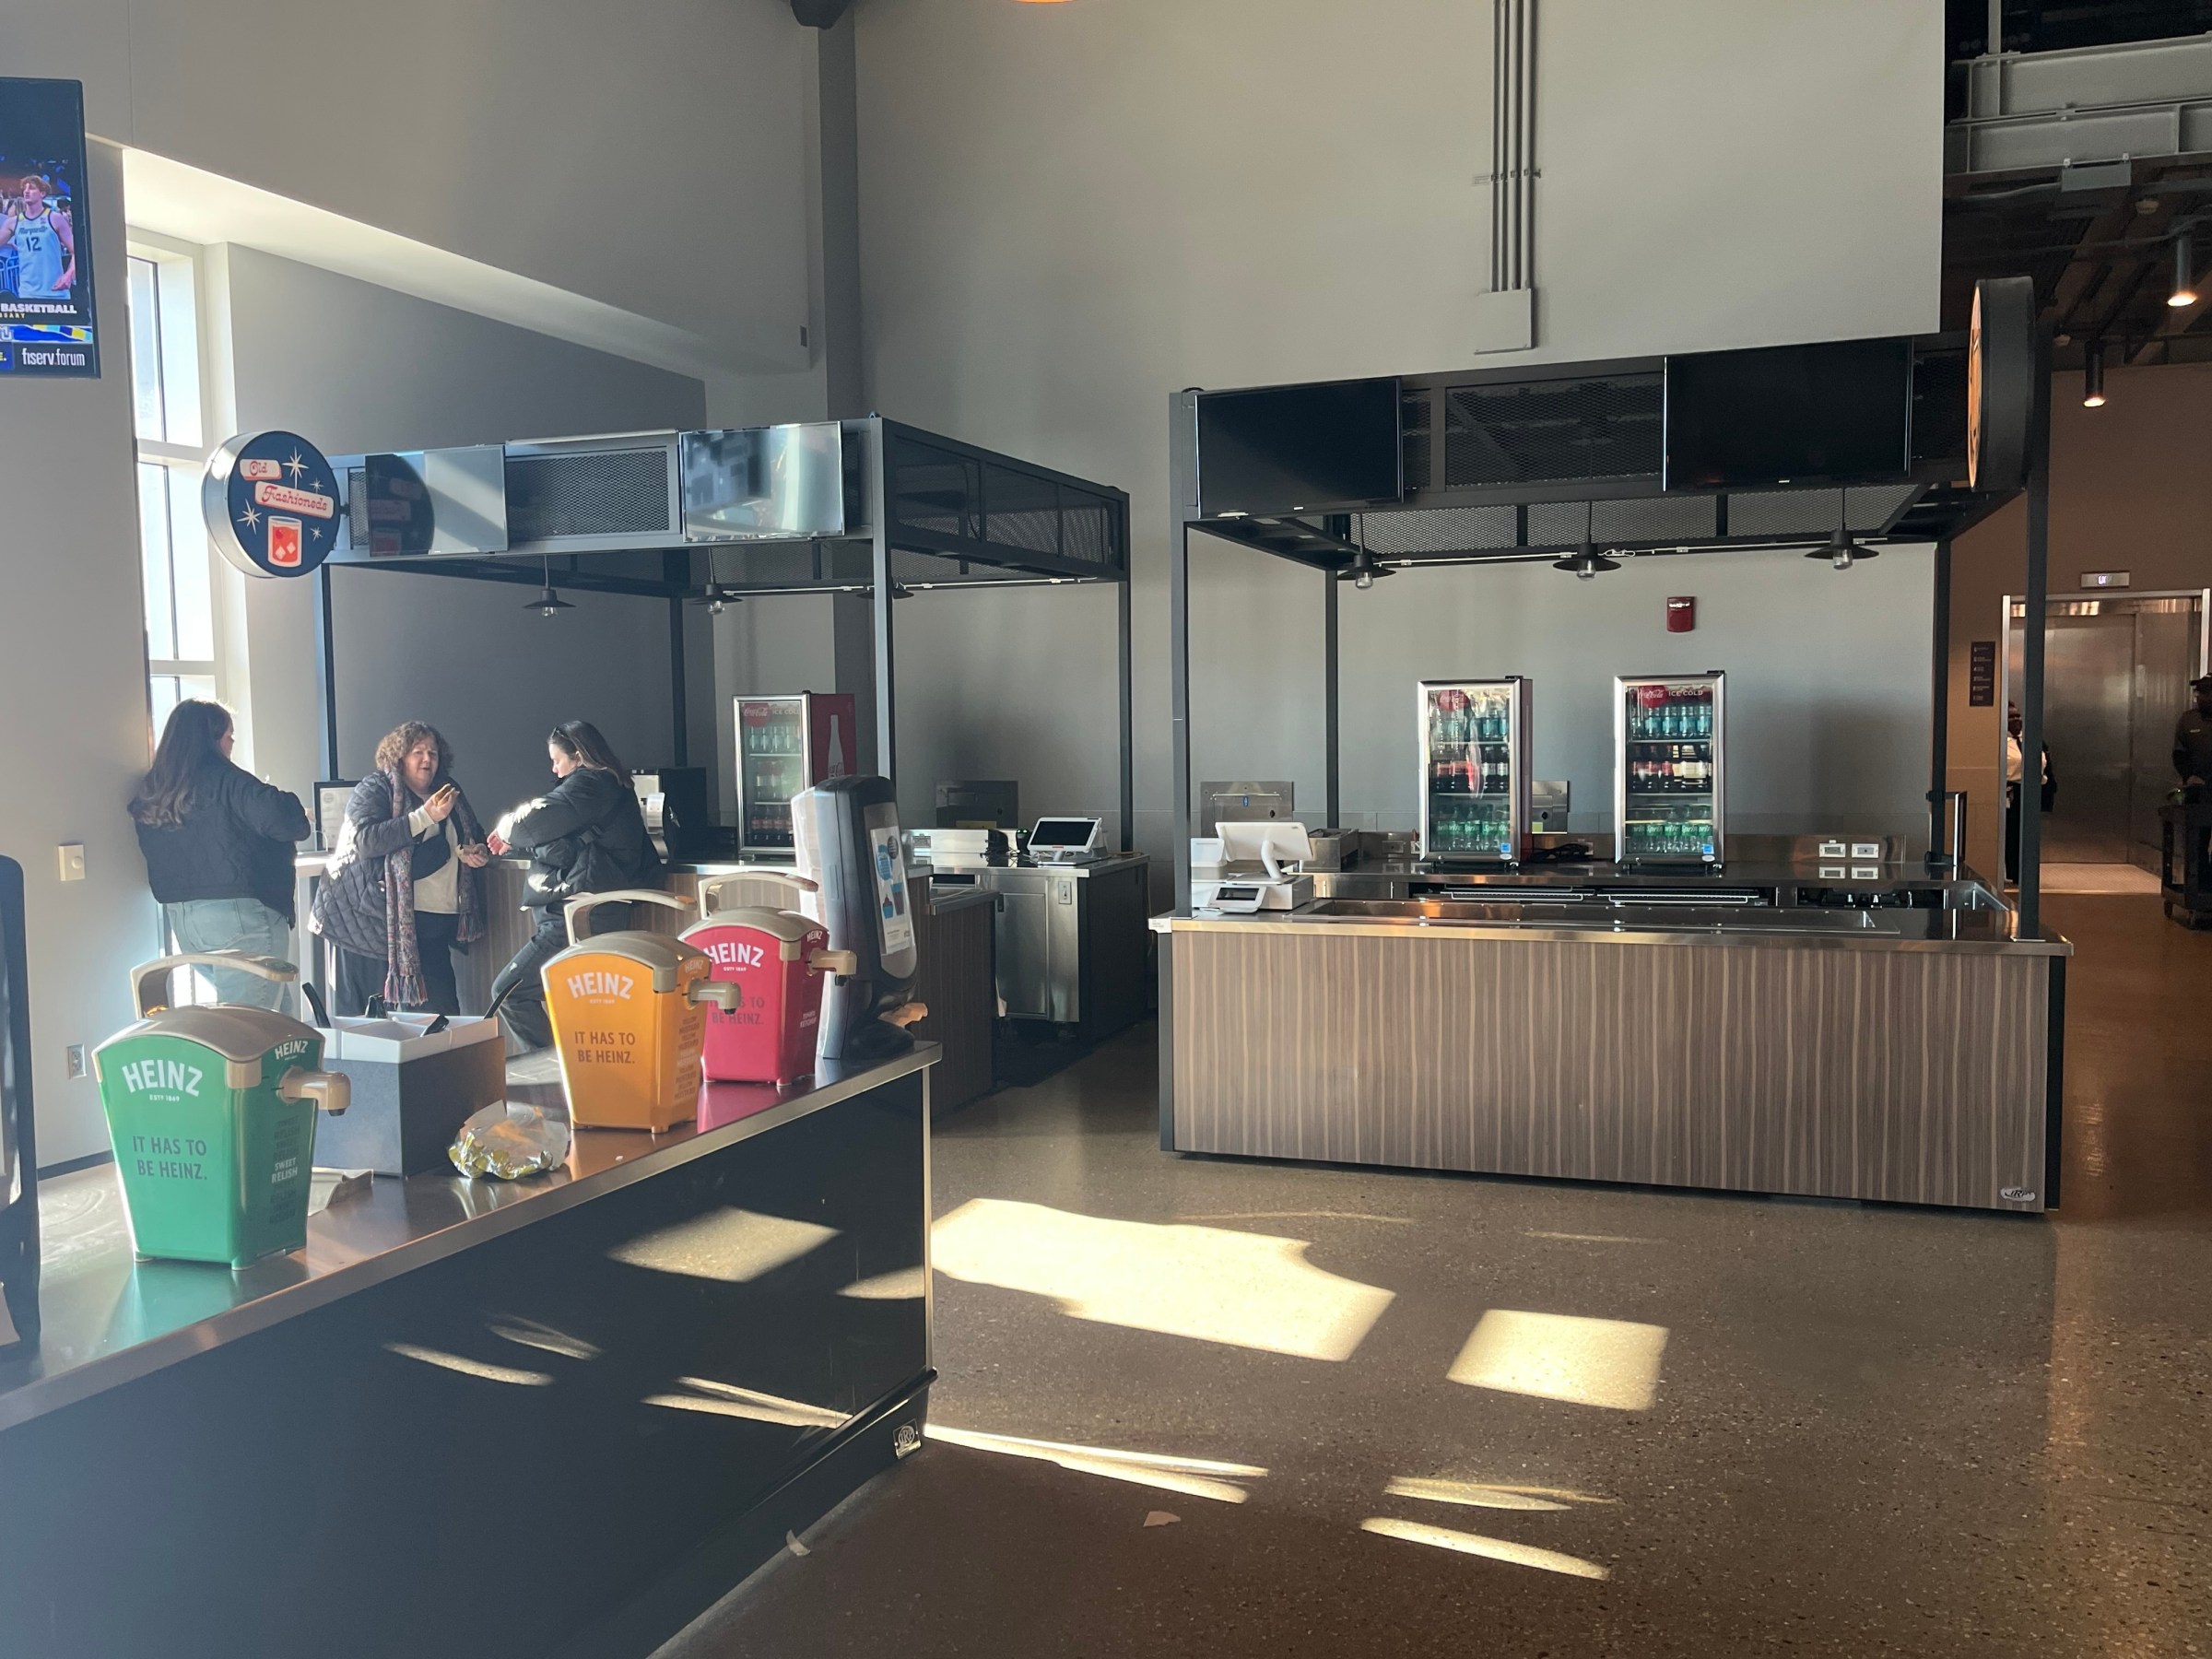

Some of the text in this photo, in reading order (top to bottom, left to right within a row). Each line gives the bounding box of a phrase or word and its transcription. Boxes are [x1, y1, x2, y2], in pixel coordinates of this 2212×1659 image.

[26, 237, 42, 252] 12
[0, 302, 77, 314] BASKETBALL
[250, 461, 268, 476] Old
[262, 485, 328, 511] Fashioneds
[806, 930, 823, 942] HEINZ
[703, 942, 764, 968] HEINZ
[685, 959, 704, 973] HEINZ
[567, 971, 634, 1000] HEINZ
[749, 996, 765, 1008] TO
[712, 1012, 725, 1024] BE
[574, 1030, 636, 1045] IT HAS TO
[275, 1040, 309, 1060] HEINZ
[577, 1049, 636, 1064] BE HEINZ.
[122, 1059, 203, 1097] HEINZ
[133, 1135, 207, 1157] IT HAS TO
[136, 1159, 207, 1180] BE HEINZ.
[275, 1158, 297, 1171] SWEET
[271, 1166, 299, 1184] RELISH
